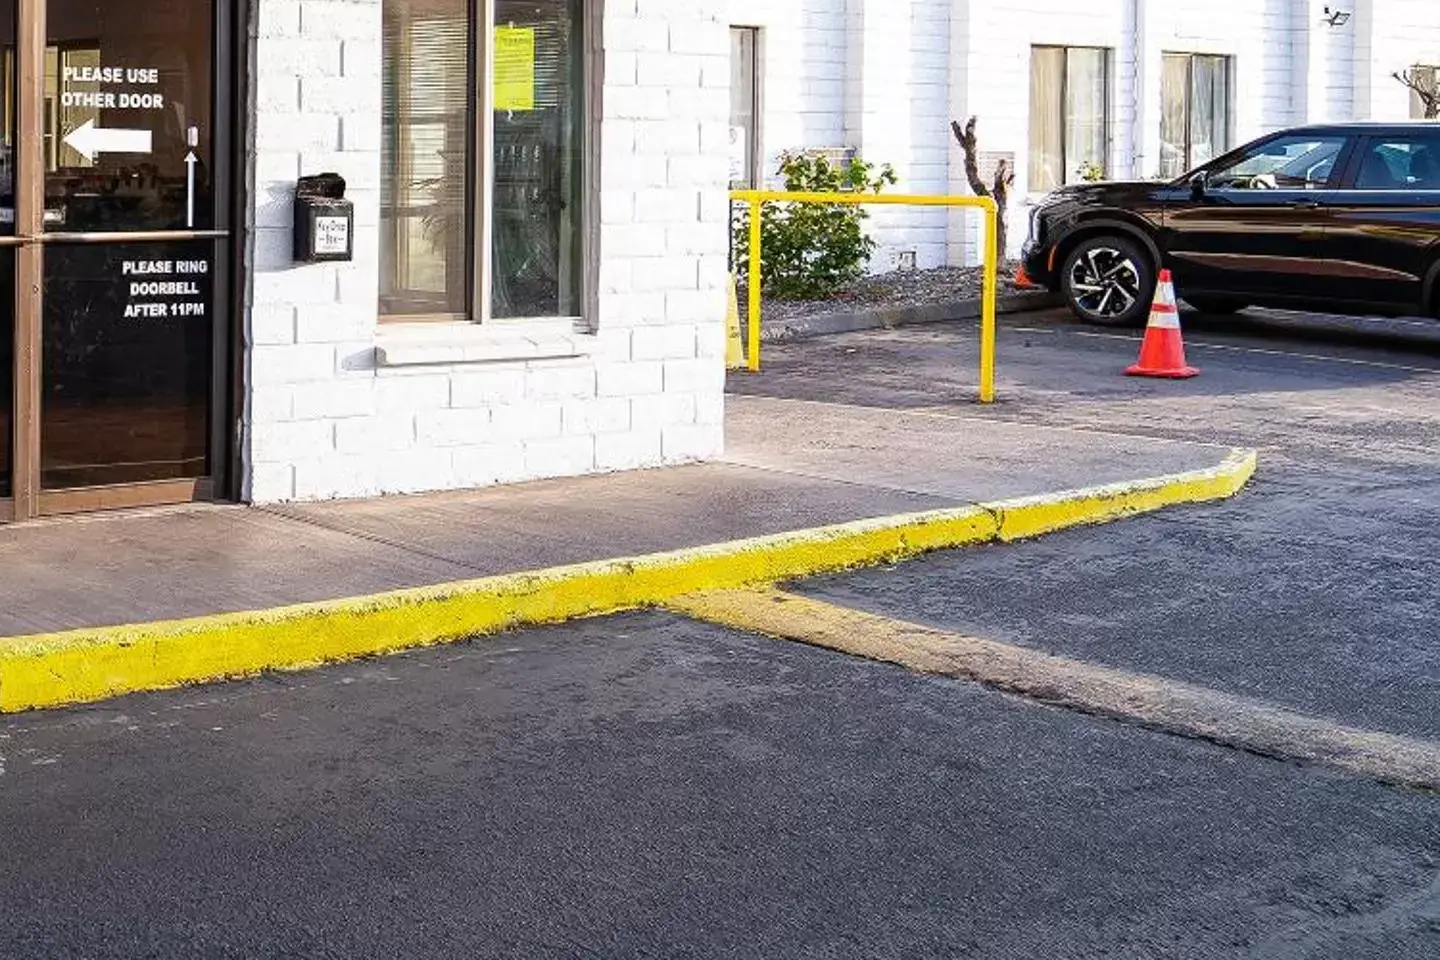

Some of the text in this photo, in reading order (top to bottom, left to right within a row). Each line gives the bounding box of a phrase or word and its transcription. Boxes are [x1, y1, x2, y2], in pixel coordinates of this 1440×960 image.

[63, 67, 158, 84] PLEASE USE
[61, 92, 164, 109] OTHER DOOR
[122, 260, 208, 275] PLEASE RING
[130, 281, 200, 296] DOORBELL
[123, 303, 205, 318] AFTER 11PM
